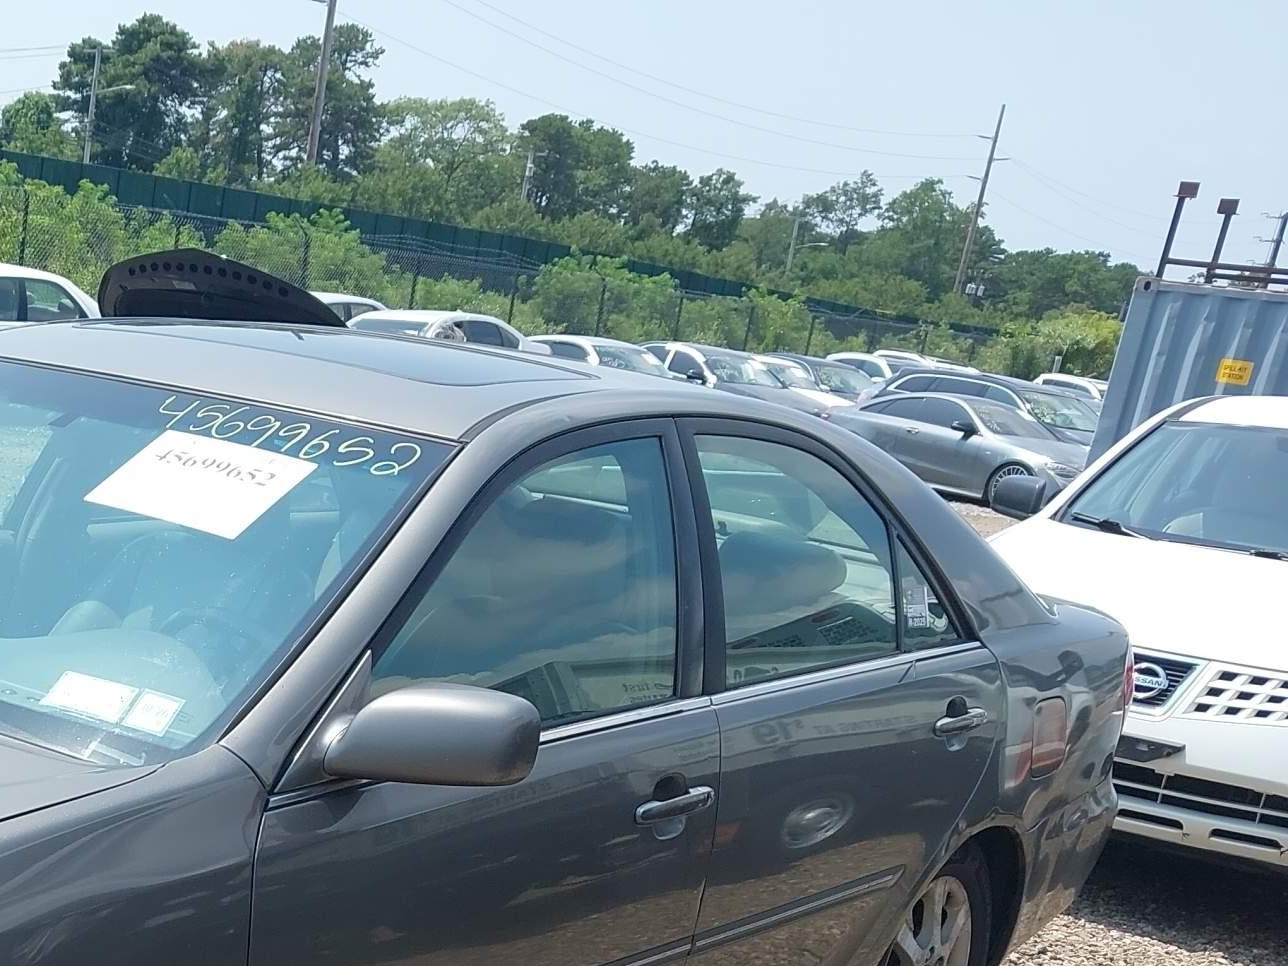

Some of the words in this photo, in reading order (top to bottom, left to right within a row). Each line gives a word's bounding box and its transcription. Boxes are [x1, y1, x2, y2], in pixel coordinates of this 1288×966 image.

[158, 394, 422, 477] 45699652
[154, 448, 278, 488] 45699652
[1134, 676, 1164, 687] SSAN
